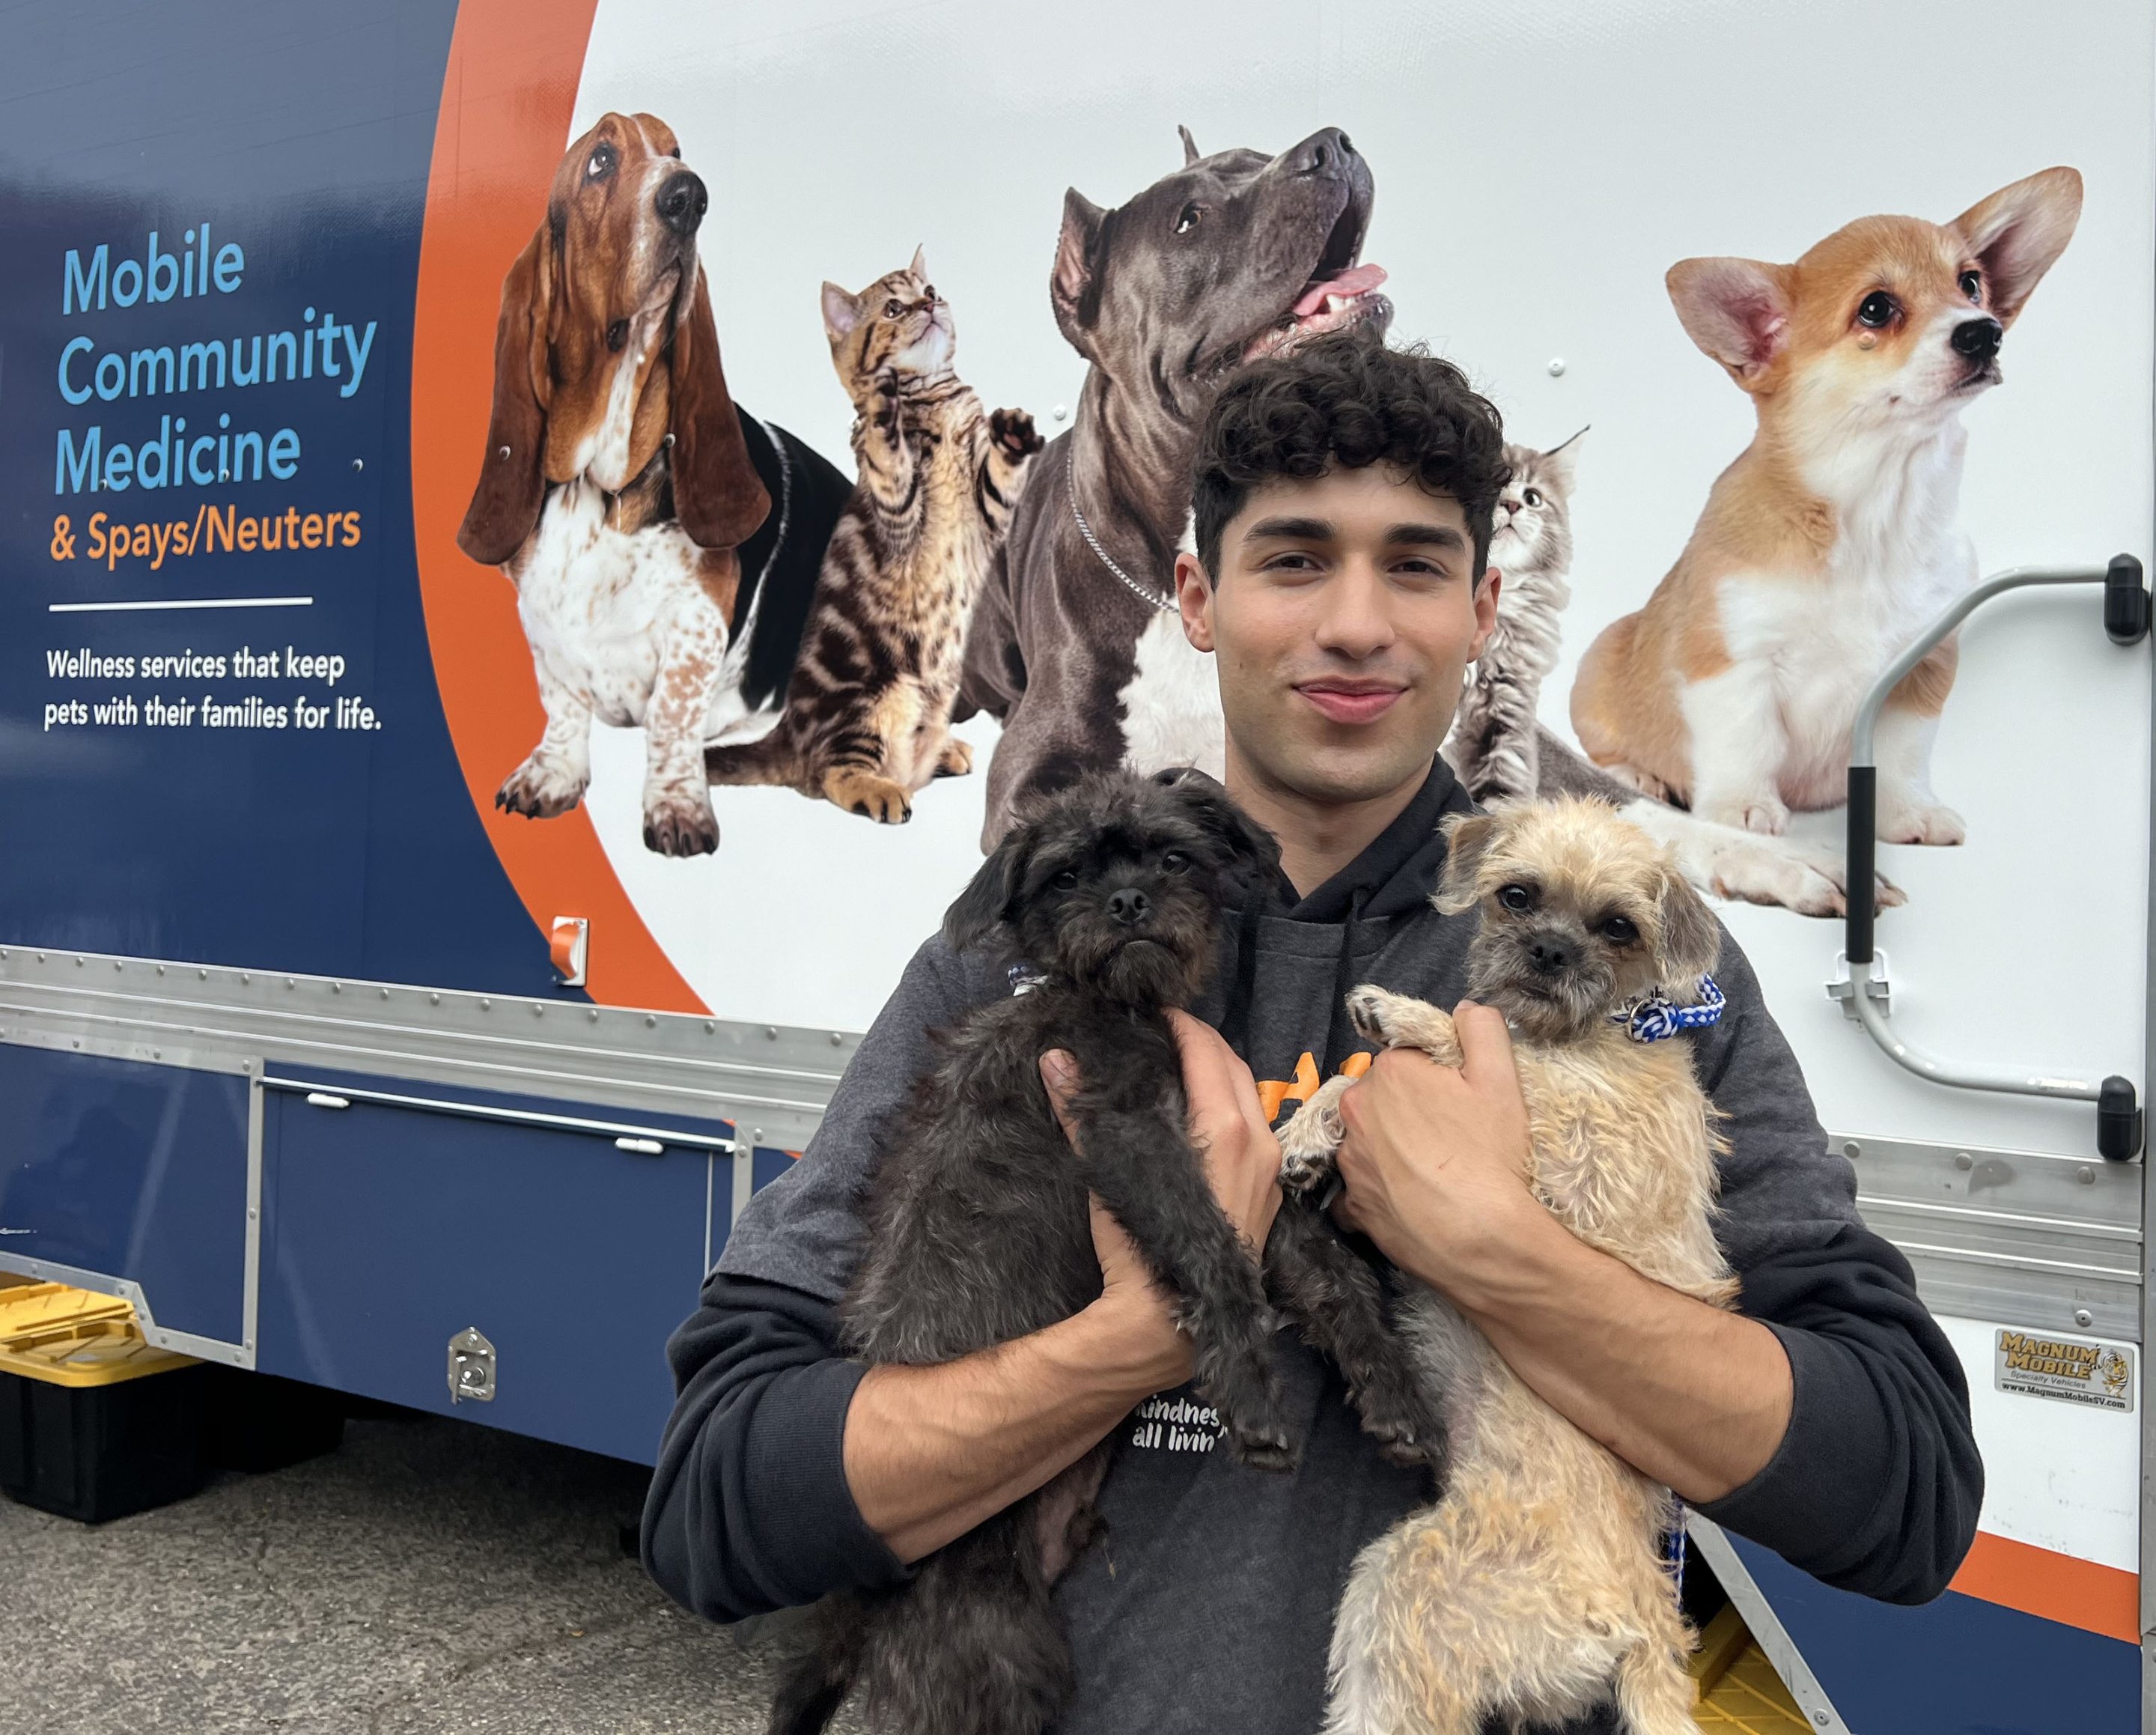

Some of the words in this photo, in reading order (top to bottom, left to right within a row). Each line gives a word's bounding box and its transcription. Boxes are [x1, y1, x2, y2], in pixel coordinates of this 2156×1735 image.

[63, 222, 244, 315] Mobile
[58, 306, 377, 405] Community
[55, 413, 301, 495] Medicine
[50, 514, 76, 562] &
[88, 504, 361, 571] Spays/Neuters
[46, 648, 135, 678] Wellness
[140, 648, 227, 678] services
[232, 645, 280, 679] that
[286, 645, 345, 687] keep
[43, 699, 88, 732] pets
[94, 694, 138, 726] with
[144, 694, 196, 727] their
[201, 694, 288, 729] families
[294, 695, 330, 729] for
[337, 696, 382, 730] life.
[2000, 1331, 2099, 1365] MAGNUM
[2006, 1351, 2091, 1380] MOBILE
[2001, 1382, 2126, 1409] www.MagnumMobileSV.com
[2010, 1370, 2048, 1385] Specialty
[2050, 1376, 2086, 1389] Vehicles
[1135, 1394, 1220, 1427] indnes
[1132, 1422, 1163, 1449] all
[1168, 1424, 1215, 1453] livin
